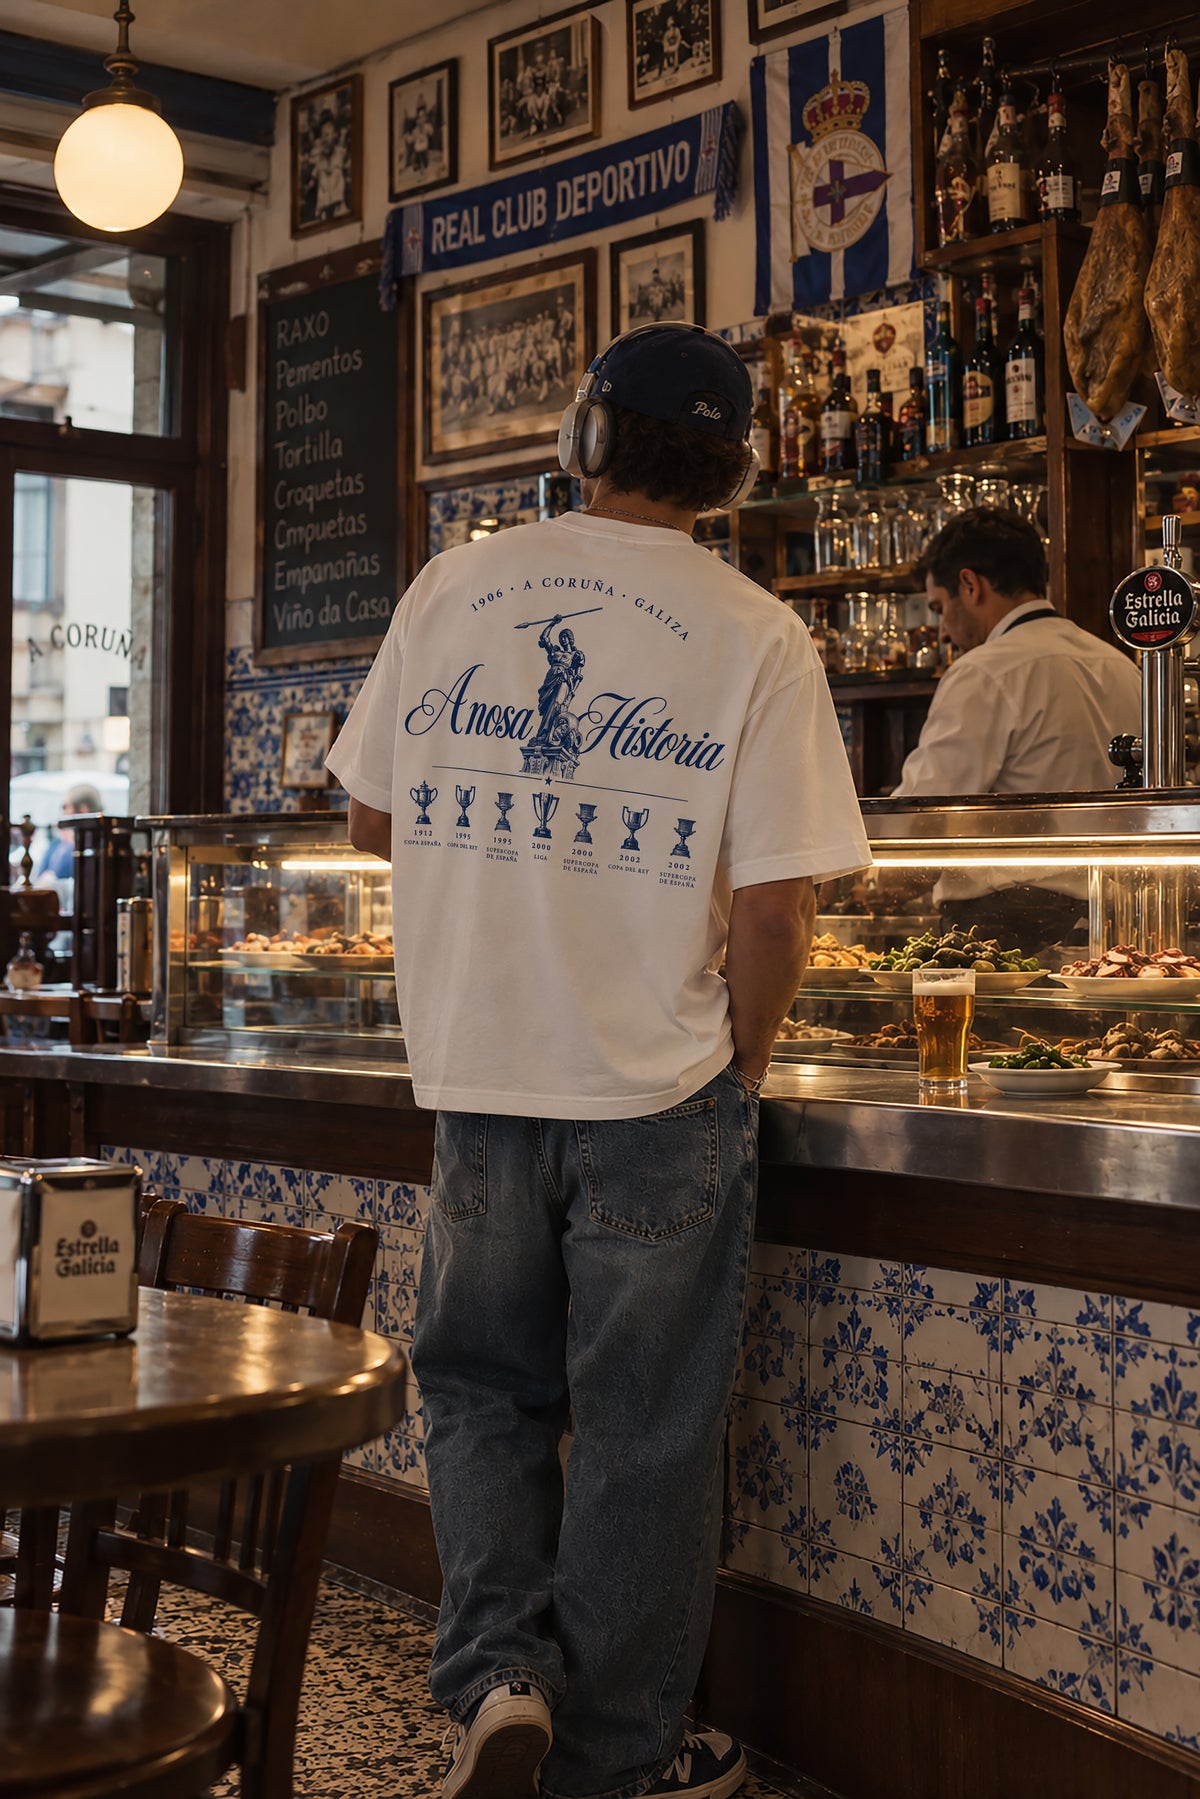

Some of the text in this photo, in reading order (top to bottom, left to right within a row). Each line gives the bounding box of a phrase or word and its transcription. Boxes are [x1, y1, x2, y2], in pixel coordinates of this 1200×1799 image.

[431, 140, 691, 255] REAL CLUB DEPORTIVO
[276, 310, 330, 350] RAXO
[275, 346, 363, 390] Pementos
[275, 393, 328, 431] Polbo
[691, 401, 722, 420] Polo
[274, 429, 343, 470] Tortilla
[274, 468, 365, 513] Croquetas
[1123, 589, 1183, 610] Estrella
[272, 590, 391, 632] Viño da Casa
[470, 577, 690, 642] 1906 A CORUÑA GALIZA
[1125, 607, 1181, 628] Galicia
[27, 637, 43, 663] A
[404, 663, 726, 772] Anosa Historia
[413, 829, 433, 837] 1912
[455, 832, 472, 840] 1995
[493, 836, 512, 845] 1995
[420, 839, 442, 847] ESPAÑA
[531, 842, 551, 851] 2000
[486, 847, 519, 857] SUPERCOPA
[495, 854, 518, 863] ESPAÑA
[571, 848, 593, 857] 2000
[619, 854, 641, 864] 2002
[563, 858, 599, 869] SUPERCOPA
[573, 866, 598, 875] ESPAÑA
[607, 863, 650, 875] COPA DEL REY
[667, 861, 690, 871] 2002
[659, 871, 697, 882] SUPERCOPA
[659, 877, 695, 889] DE ESPAÑA
[55, 1236, 120, 1258] Estrella
[56, 1256, 116, 1278] Galicia
